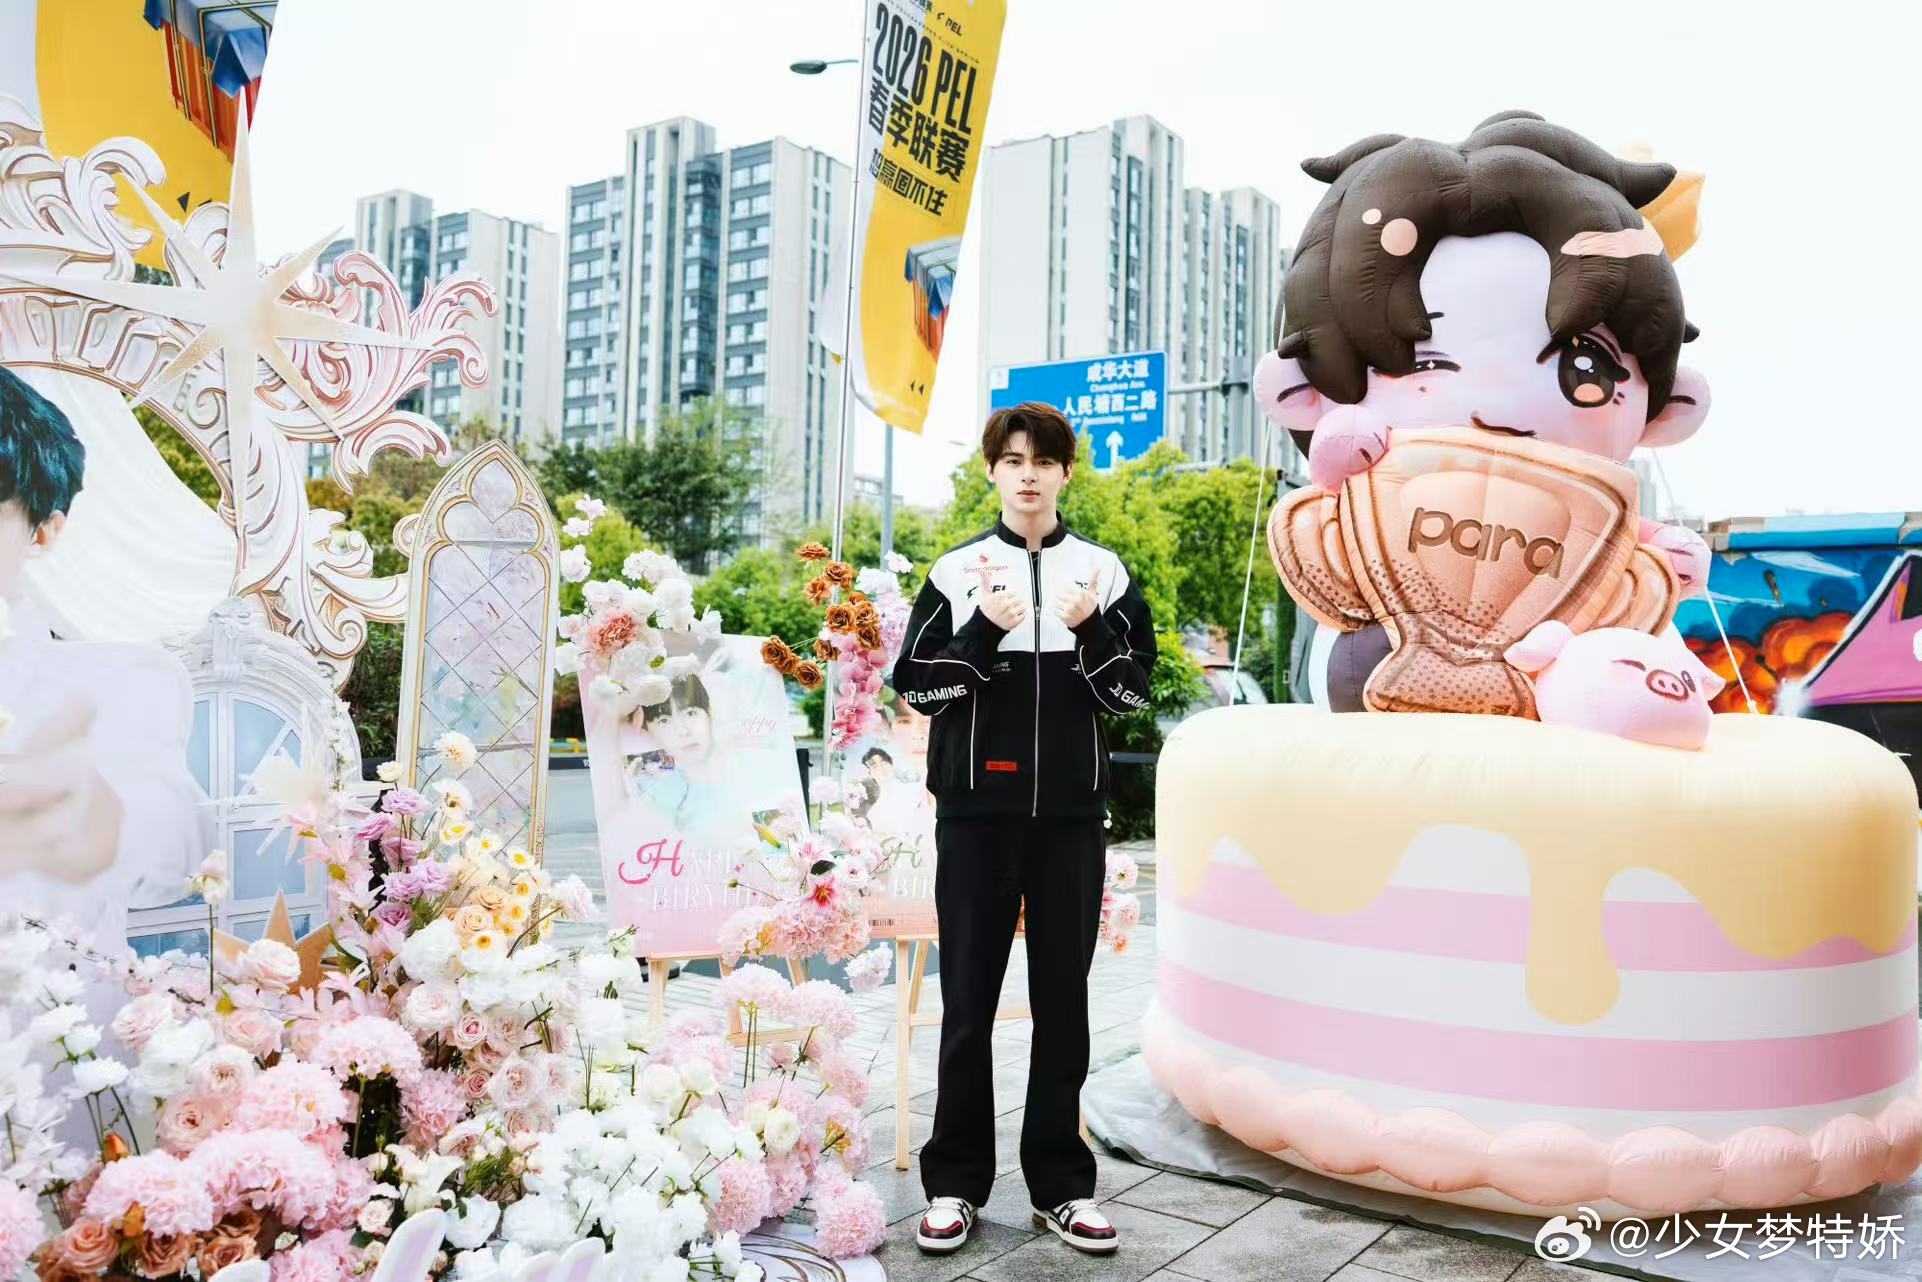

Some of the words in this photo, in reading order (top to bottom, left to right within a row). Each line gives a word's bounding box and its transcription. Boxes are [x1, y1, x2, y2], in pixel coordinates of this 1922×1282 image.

[873, 3, 933, 105] 2026
[931, 50, 979, 134] PEL
[869, 76, 970, 184] 春季联赛
[1086, 358, 1150, 383] 成华大道
[1407, 506, 1566, 579] para
[917, 684, 968, 704] GAMING
